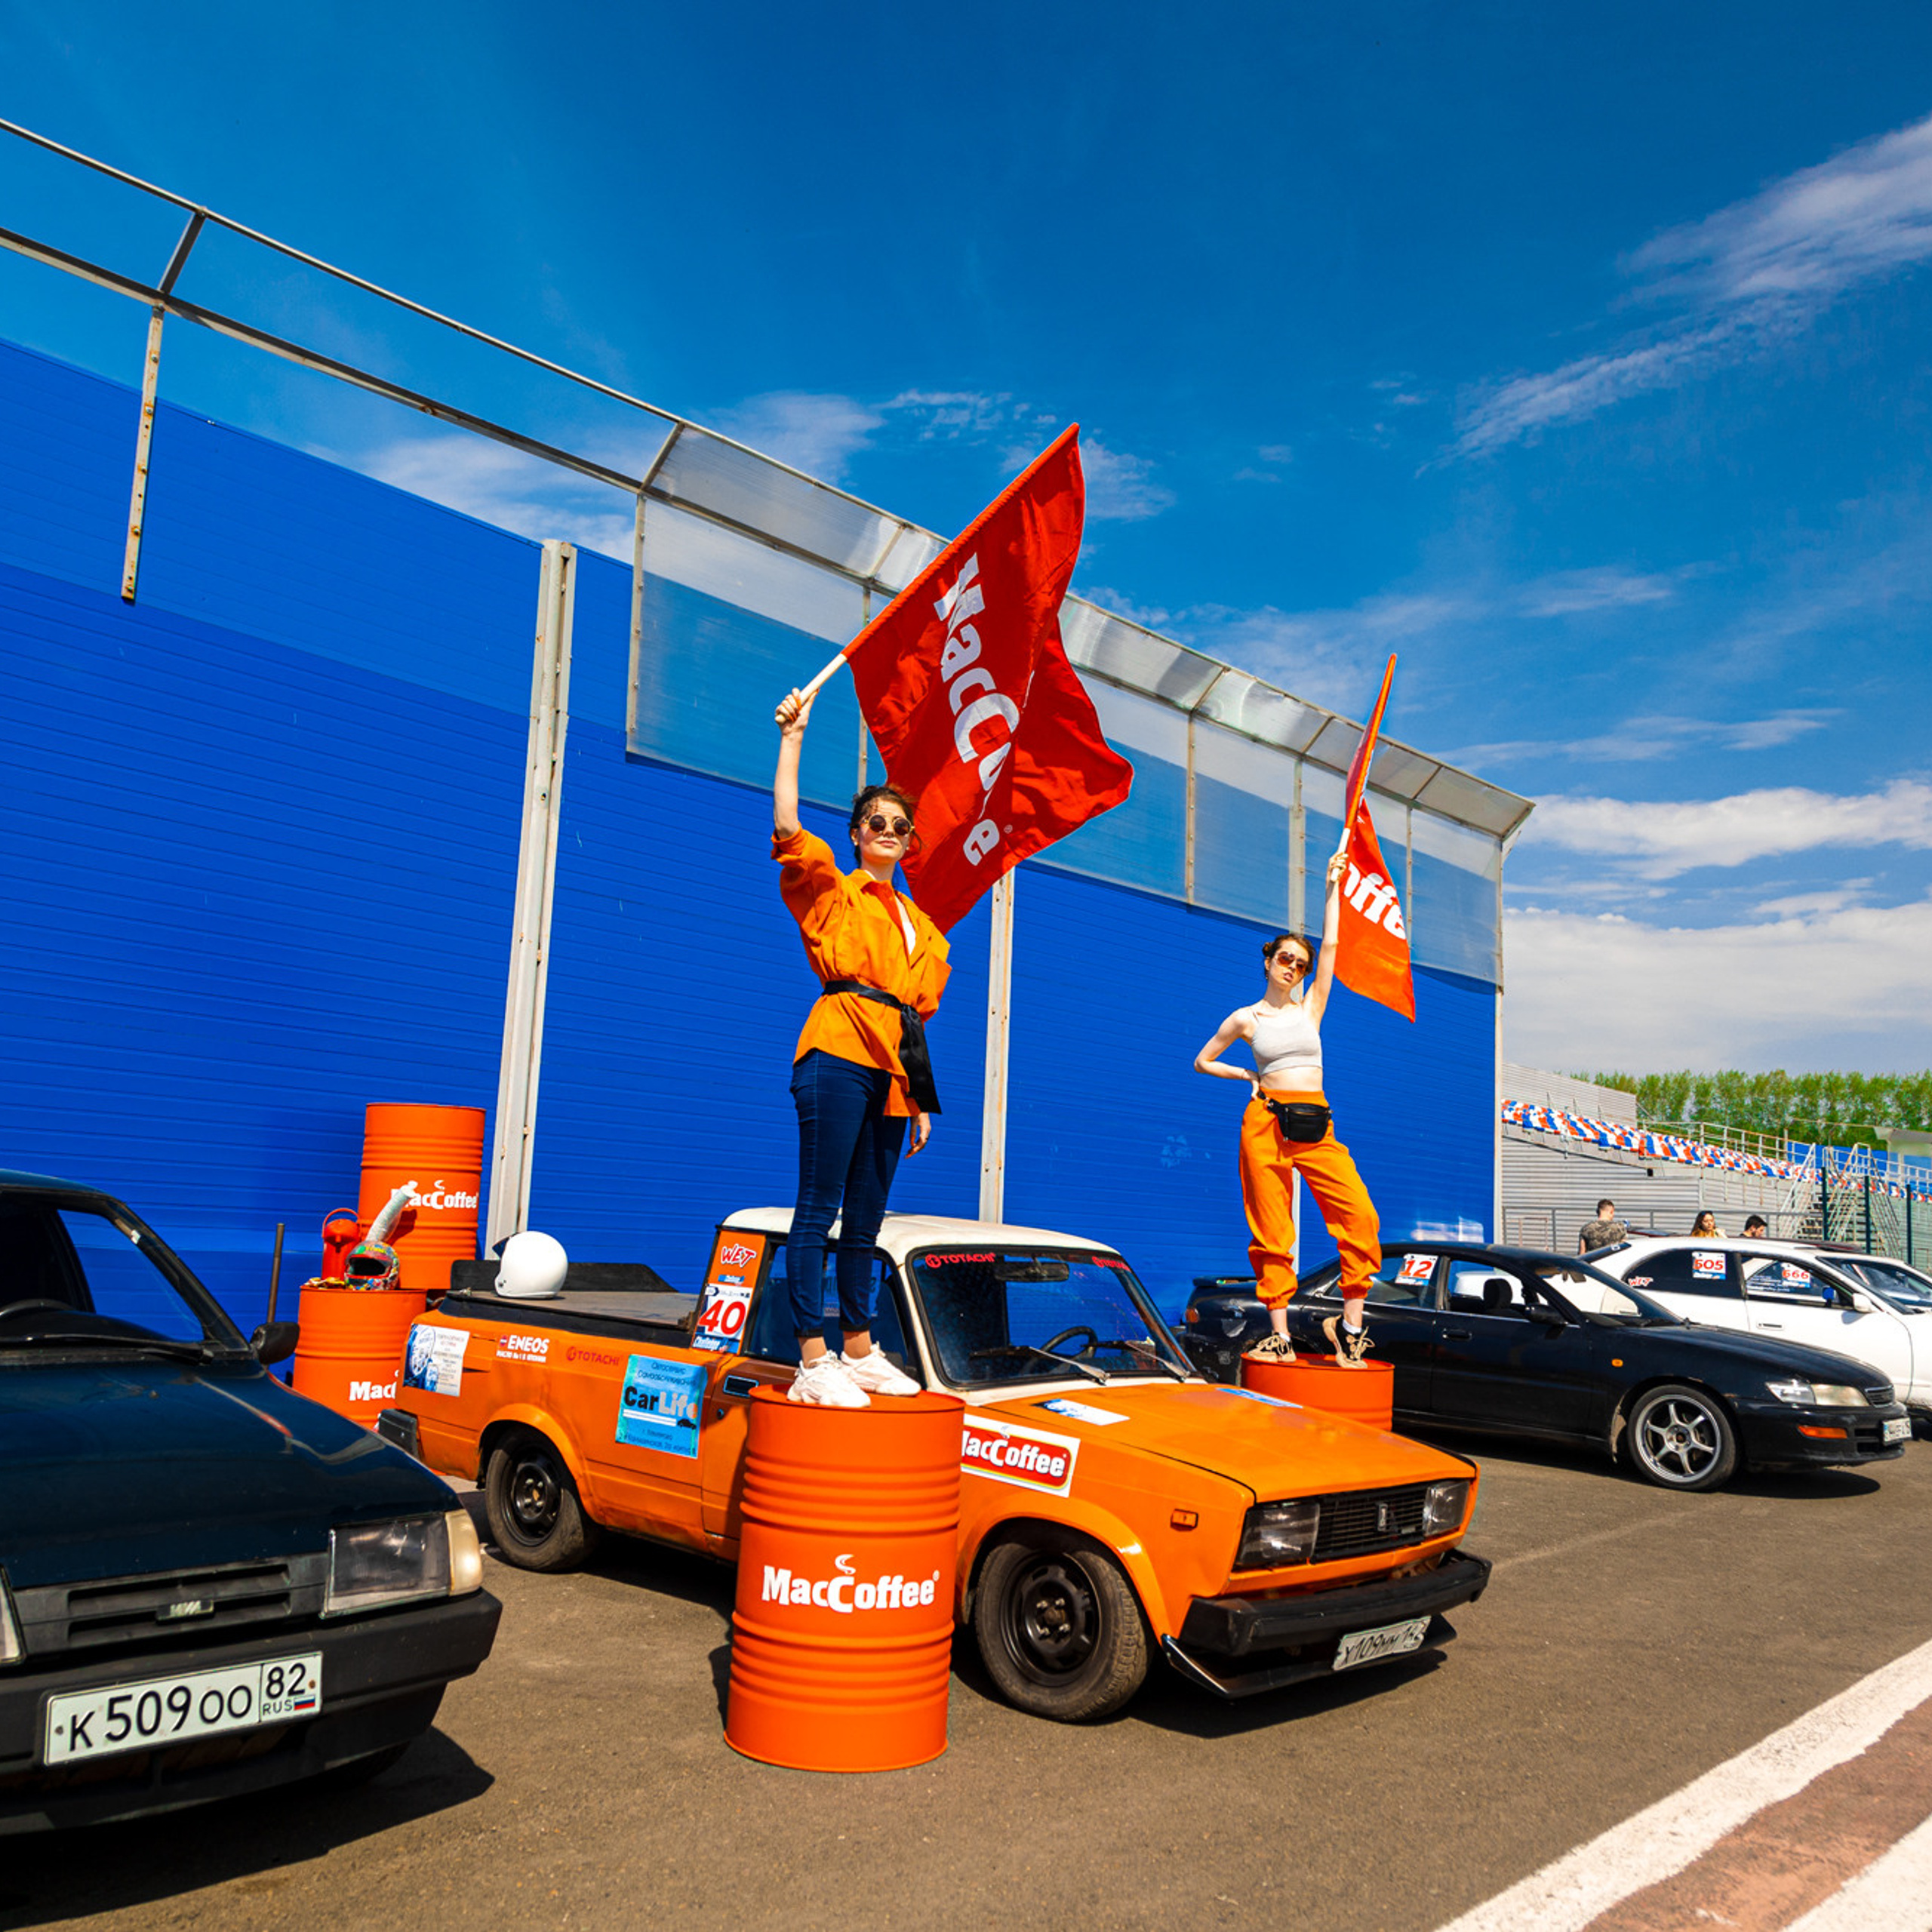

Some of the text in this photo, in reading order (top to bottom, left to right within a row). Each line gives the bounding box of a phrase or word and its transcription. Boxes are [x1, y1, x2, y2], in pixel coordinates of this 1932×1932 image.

[721, 1244, 756, 1268] WET
[940, 1254, 995, 1263] TOTACHI
[1398, 1260, 1432, 1278] 12
[1782, 1269, 1810, 1280] 666
[698, 1300, 746, 1335] 40
[507, 1334, 550, 1354] ENEOS
[577, 1350, 620, 1367] TOTACHI
[624, 1386, 699, 1420] CarLife
[761, 1565, 936, 1614] MacCoffee
[265, 1663, 306, 1700] 82
[262, 1699, 293, 1716] RUS
